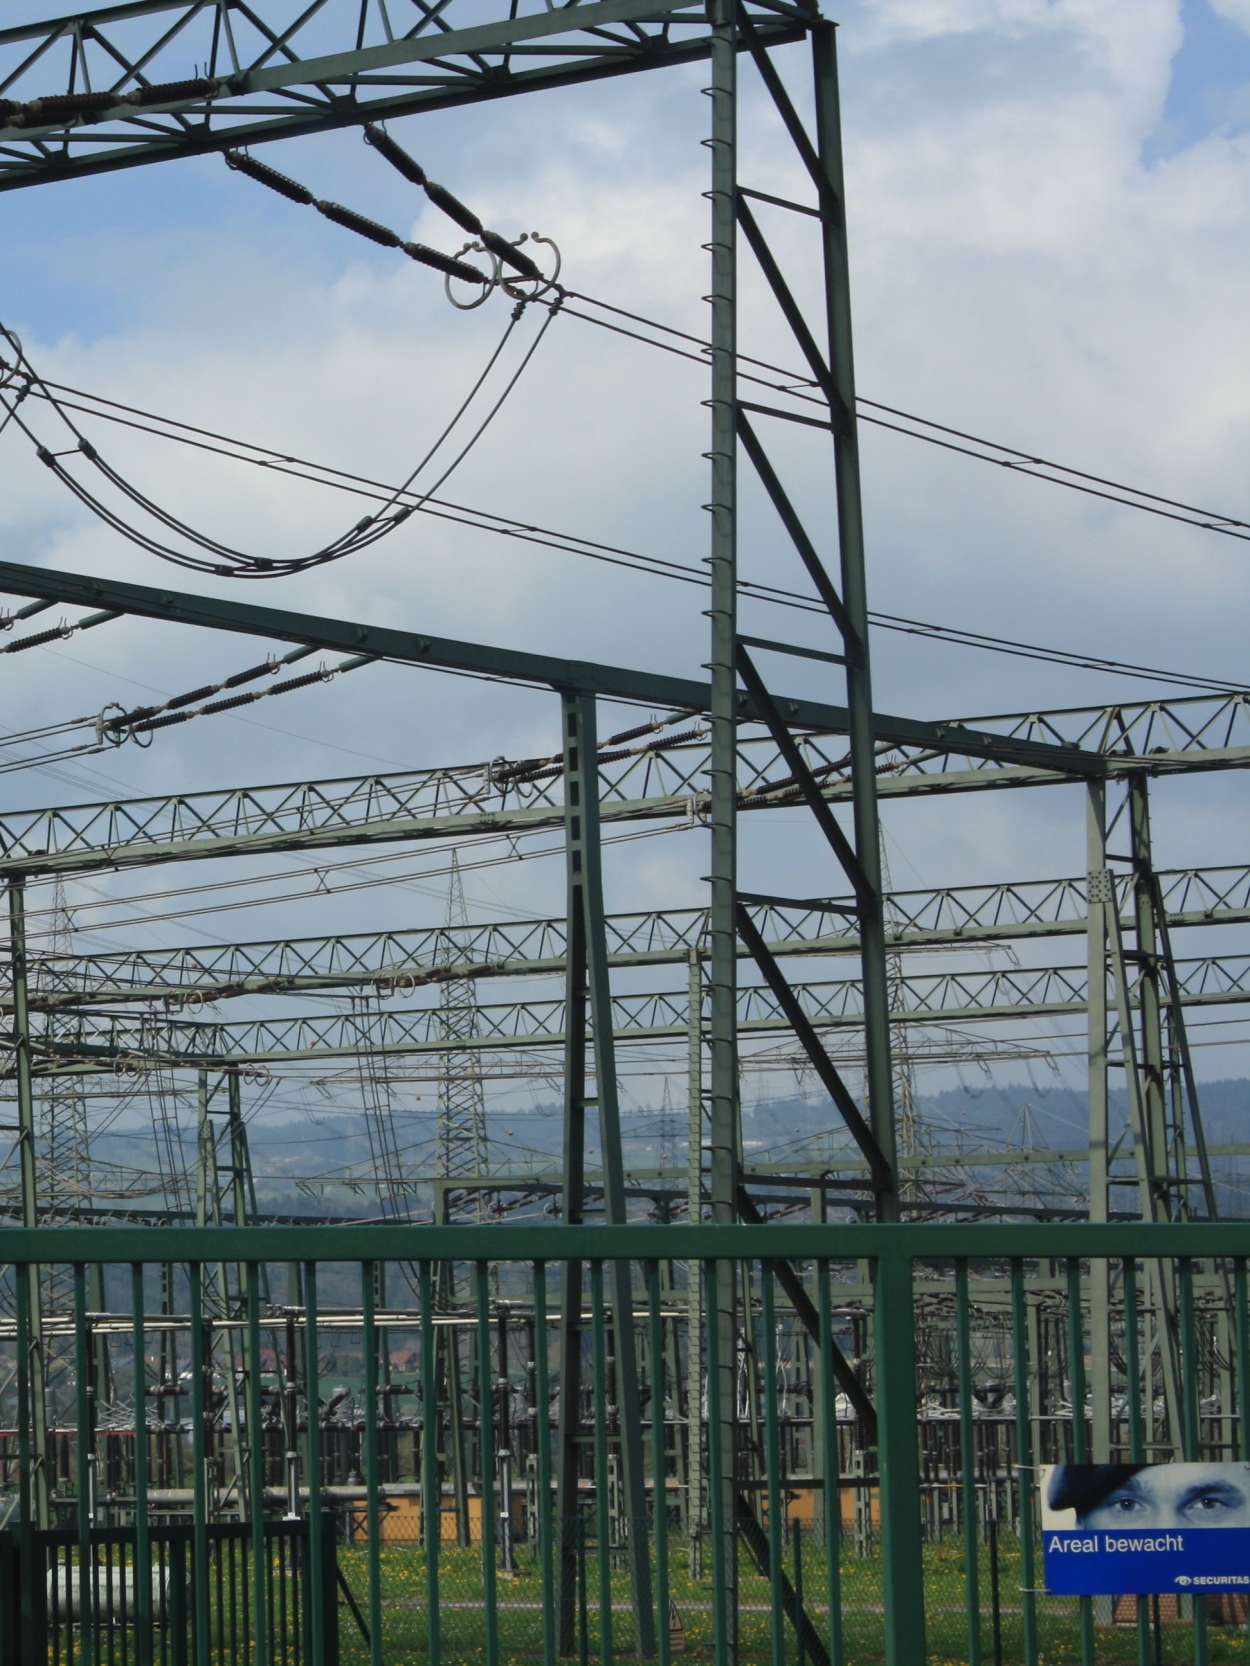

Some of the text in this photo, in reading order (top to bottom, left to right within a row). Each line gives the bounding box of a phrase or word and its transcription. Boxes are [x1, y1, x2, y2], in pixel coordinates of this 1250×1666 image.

[1048, 1534, 1185, 1553] Areal bewacht
[1192, 1575, 1250, 1586] SECURITAS
